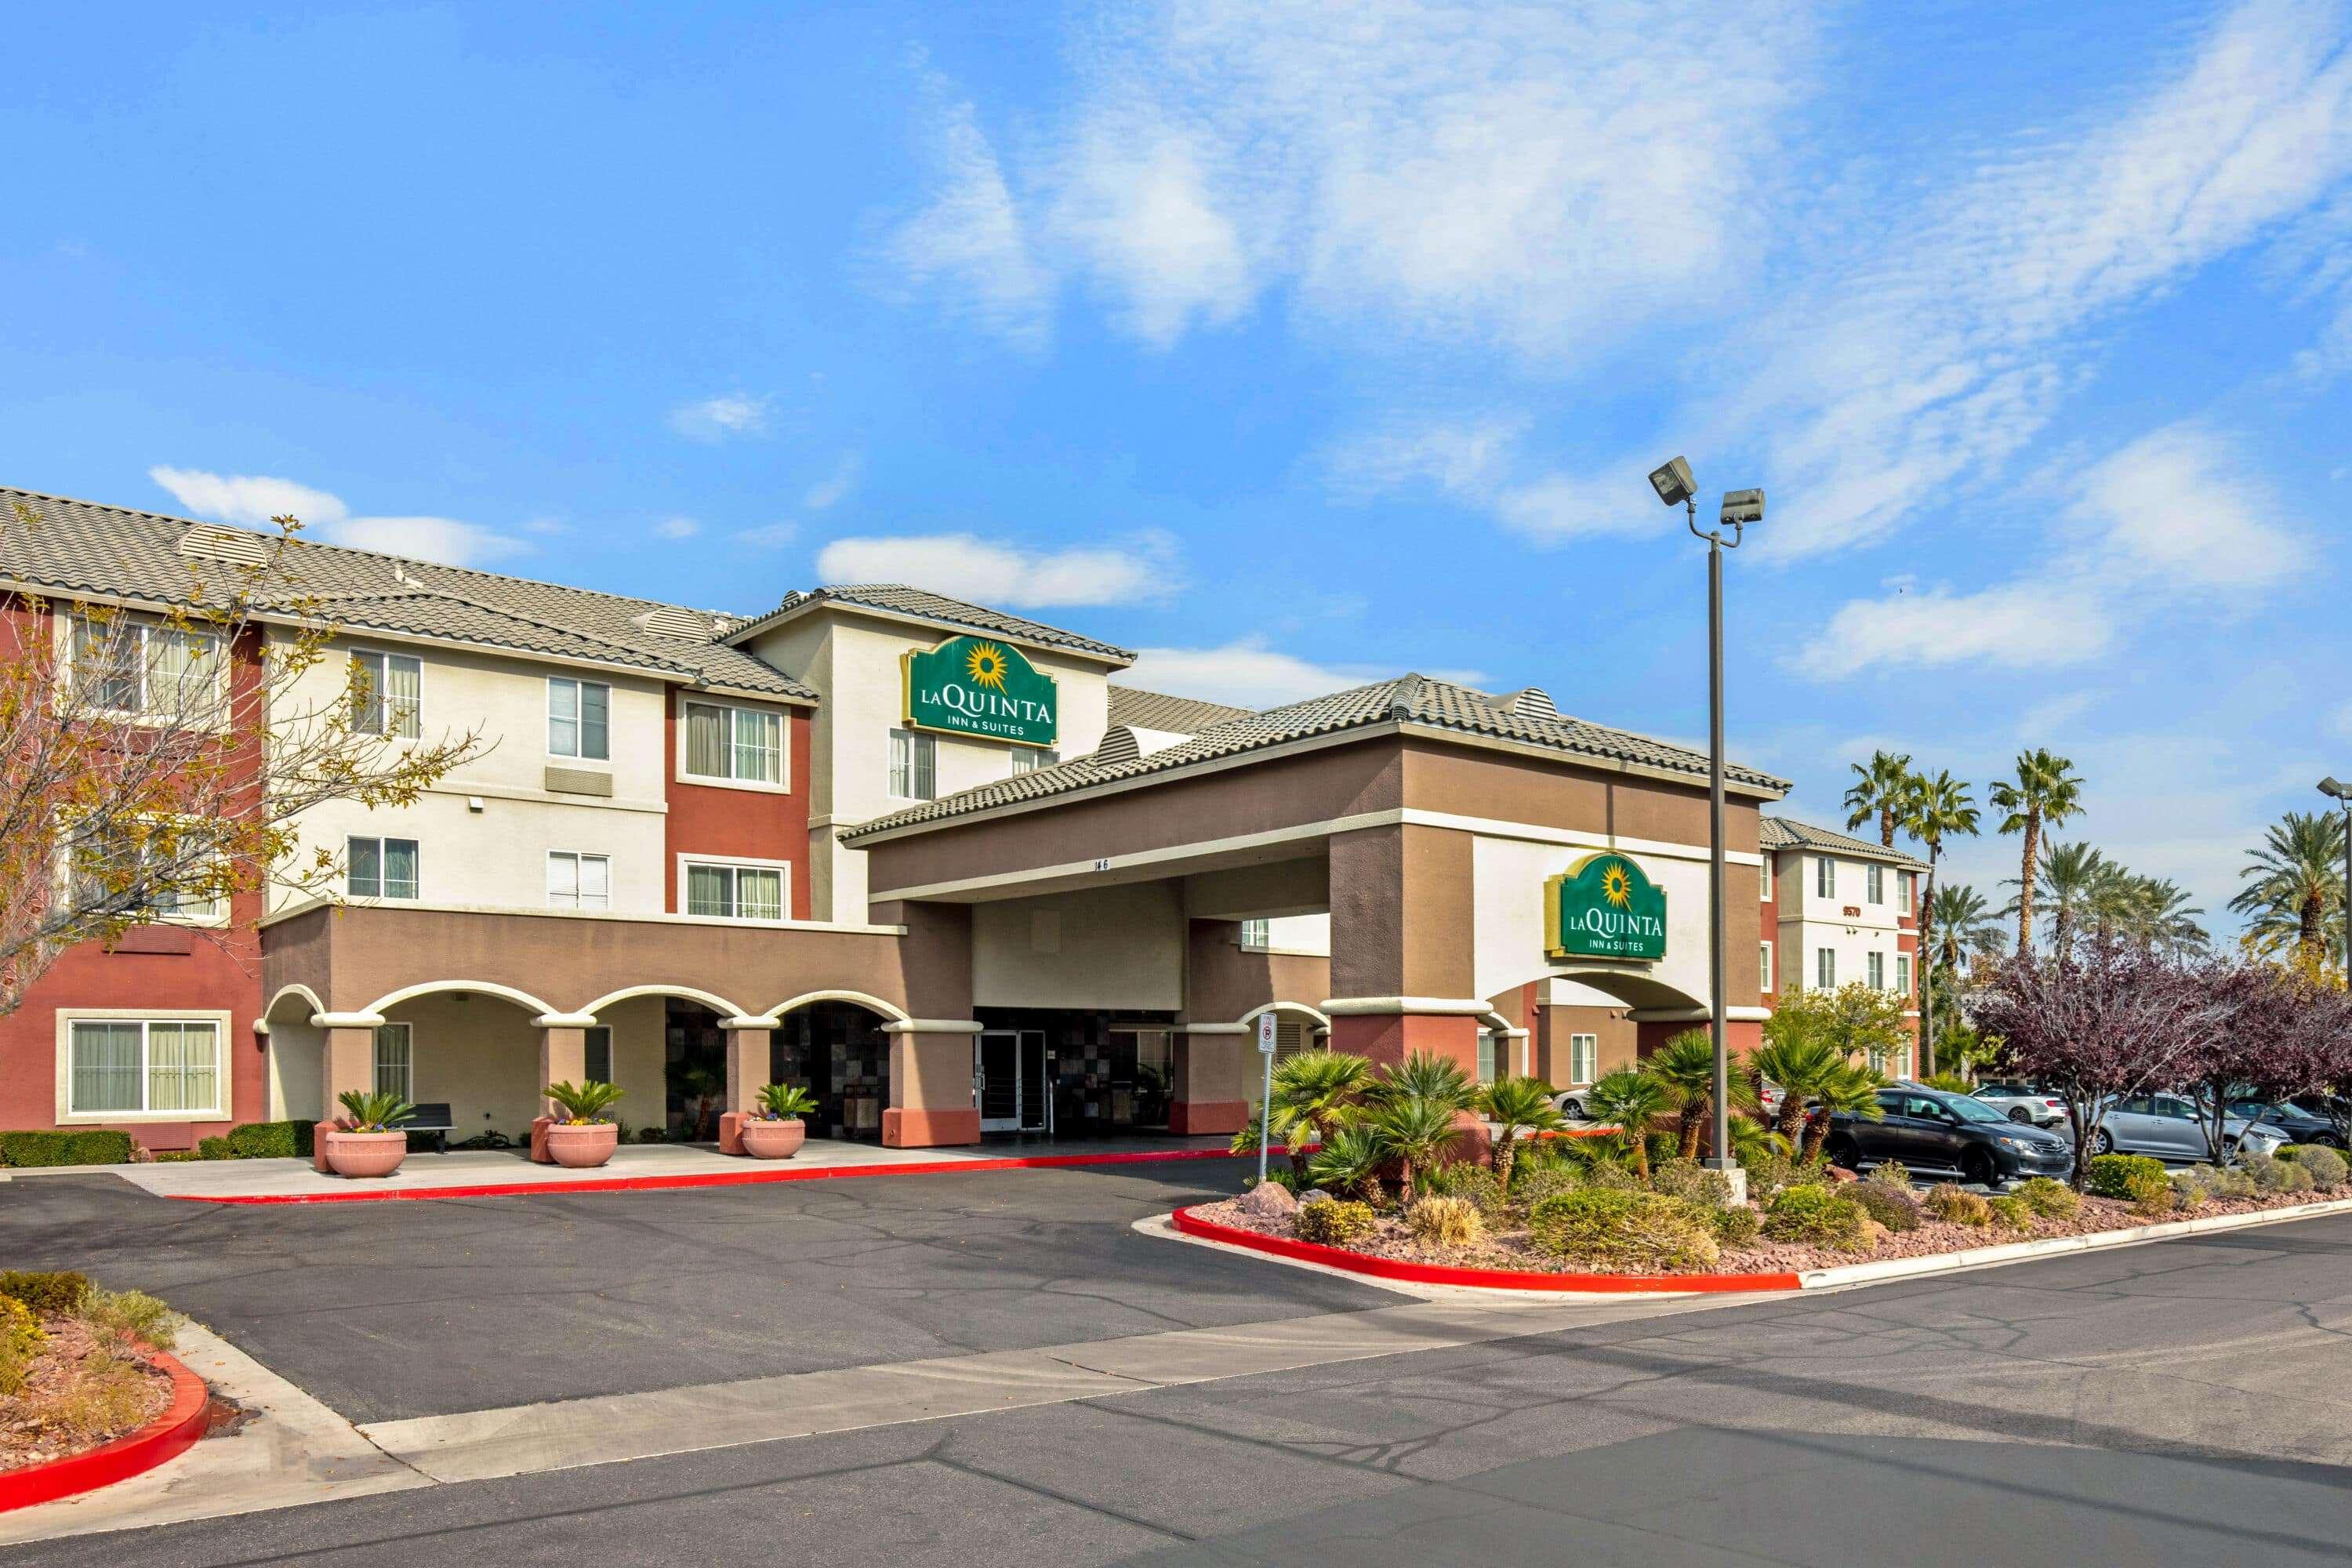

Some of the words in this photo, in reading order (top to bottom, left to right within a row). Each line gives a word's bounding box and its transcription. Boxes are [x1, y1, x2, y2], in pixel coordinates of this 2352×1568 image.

[921, 689, 942, 706] LA
[942, 684, 1052, 724] QUINTA
[947, 714, 969, 728] INN
[971, 720, 978, 729] &
[982, 720, 1025, 736] SUITES
[1570, 916, 1586, 931] LA
[1586, 908, 1663, 938] QUINTA
[1589, 939, 1604, 949] INN
[1613, 941, 1643, 952] SUITES
